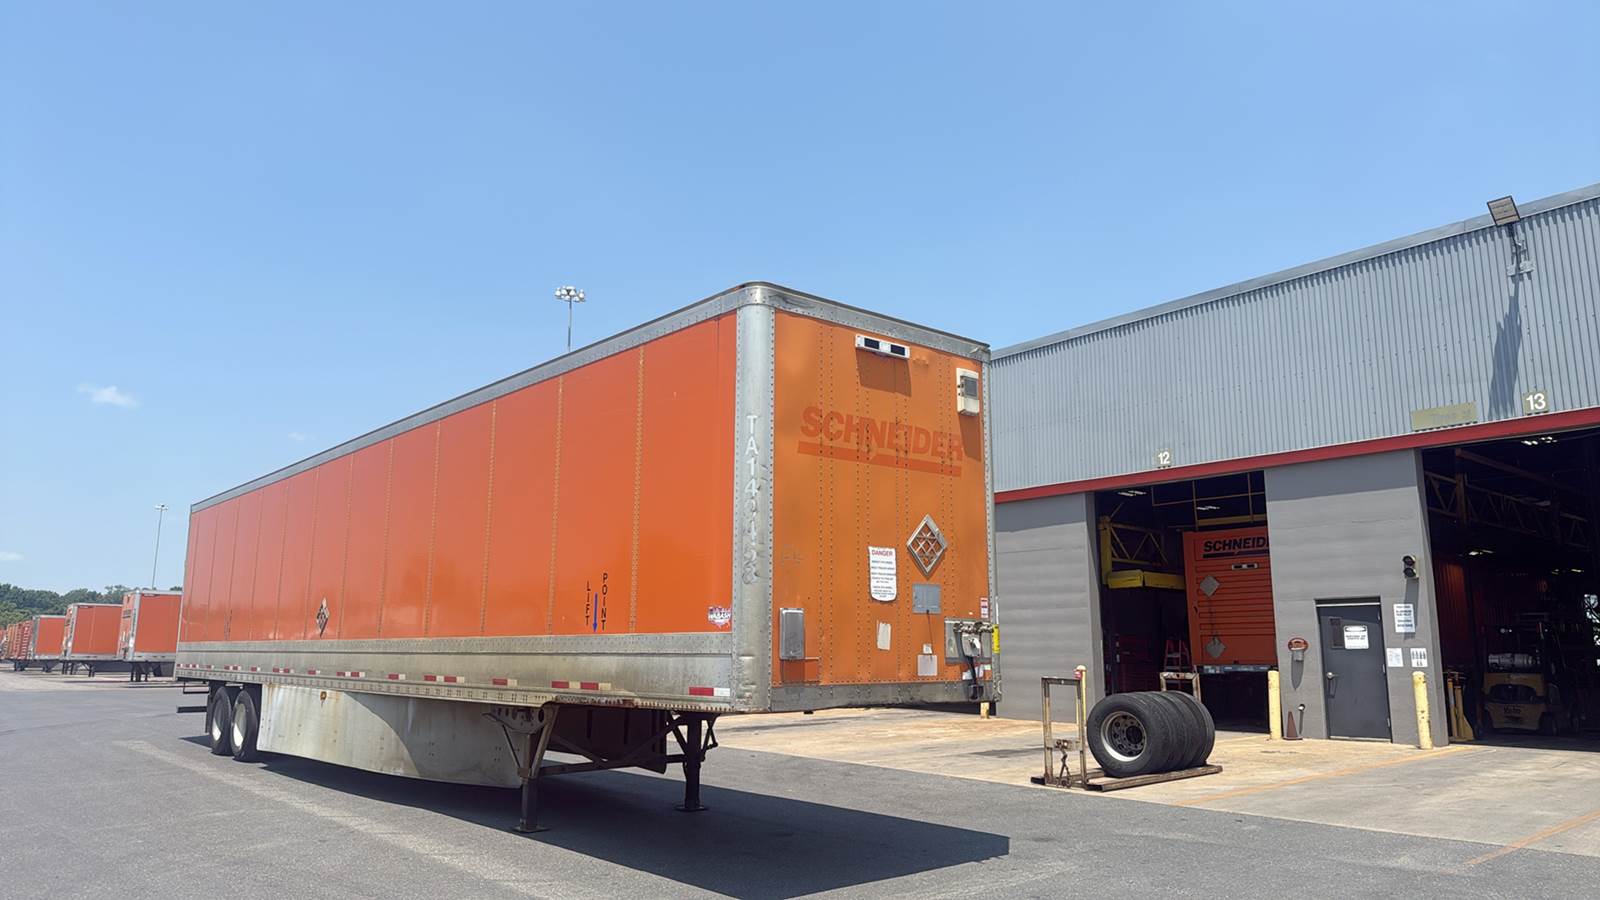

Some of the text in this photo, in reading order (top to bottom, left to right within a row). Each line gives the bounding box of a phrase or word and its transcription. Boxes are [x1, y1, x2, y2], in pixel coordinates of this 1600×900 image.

[1526, 393, 1546, 410] 13
[801, 406, 964, 461] SCHNEIDER
[1158, 451, 1171, 464] 12
[1203, 536, 1270, 552] SCHNEID
